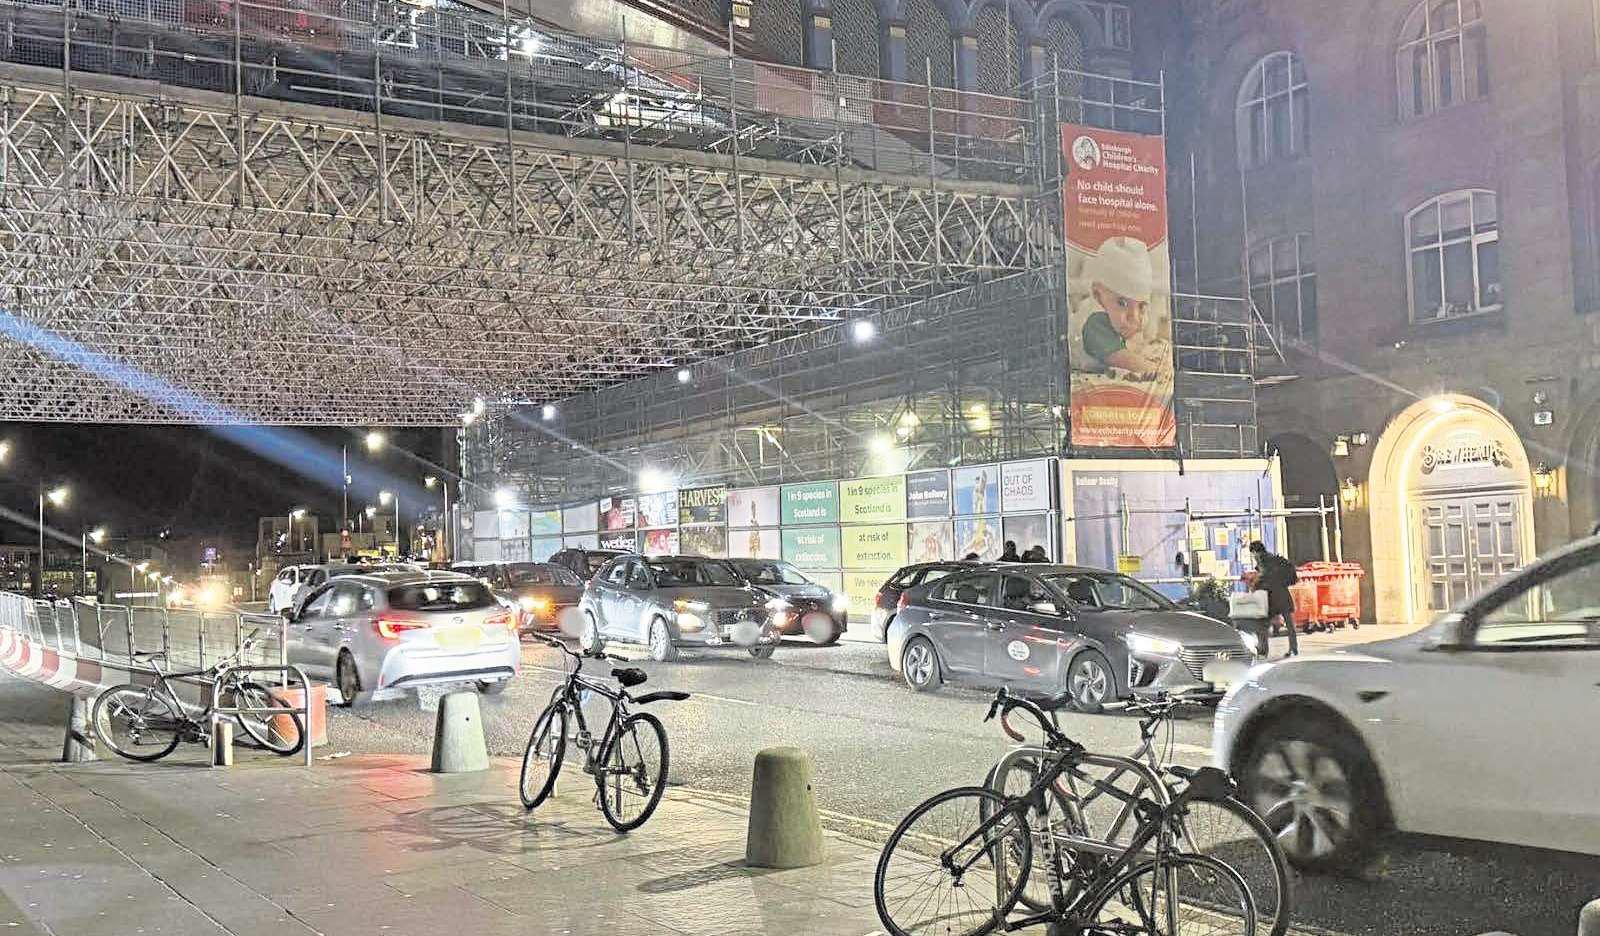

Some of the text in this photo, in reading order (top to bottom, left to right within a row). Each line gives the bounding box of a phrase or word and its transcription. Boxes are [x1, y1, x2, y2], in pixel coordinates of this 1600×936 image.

[1077, 180, 1144, 195] No child should
[1098, 195, 1133, 209] hospital
[1004, 474, 1033, 485] OUT OF
[851, 486, 858, 495] in
[859, 485, 864, 494] 9
[864, 483, 890, 495] species
[892, 483, 898, 492] in
[1004, 485, 1033, 496] CHAOS
[680, 487, 728, 507] HARVEST
[908, 491, 923, 500] John
[793, 506, 820, 518] Scotland
[854, 504, 891, 515] Scotland is
[859, 532, 888, 542] at risk of
